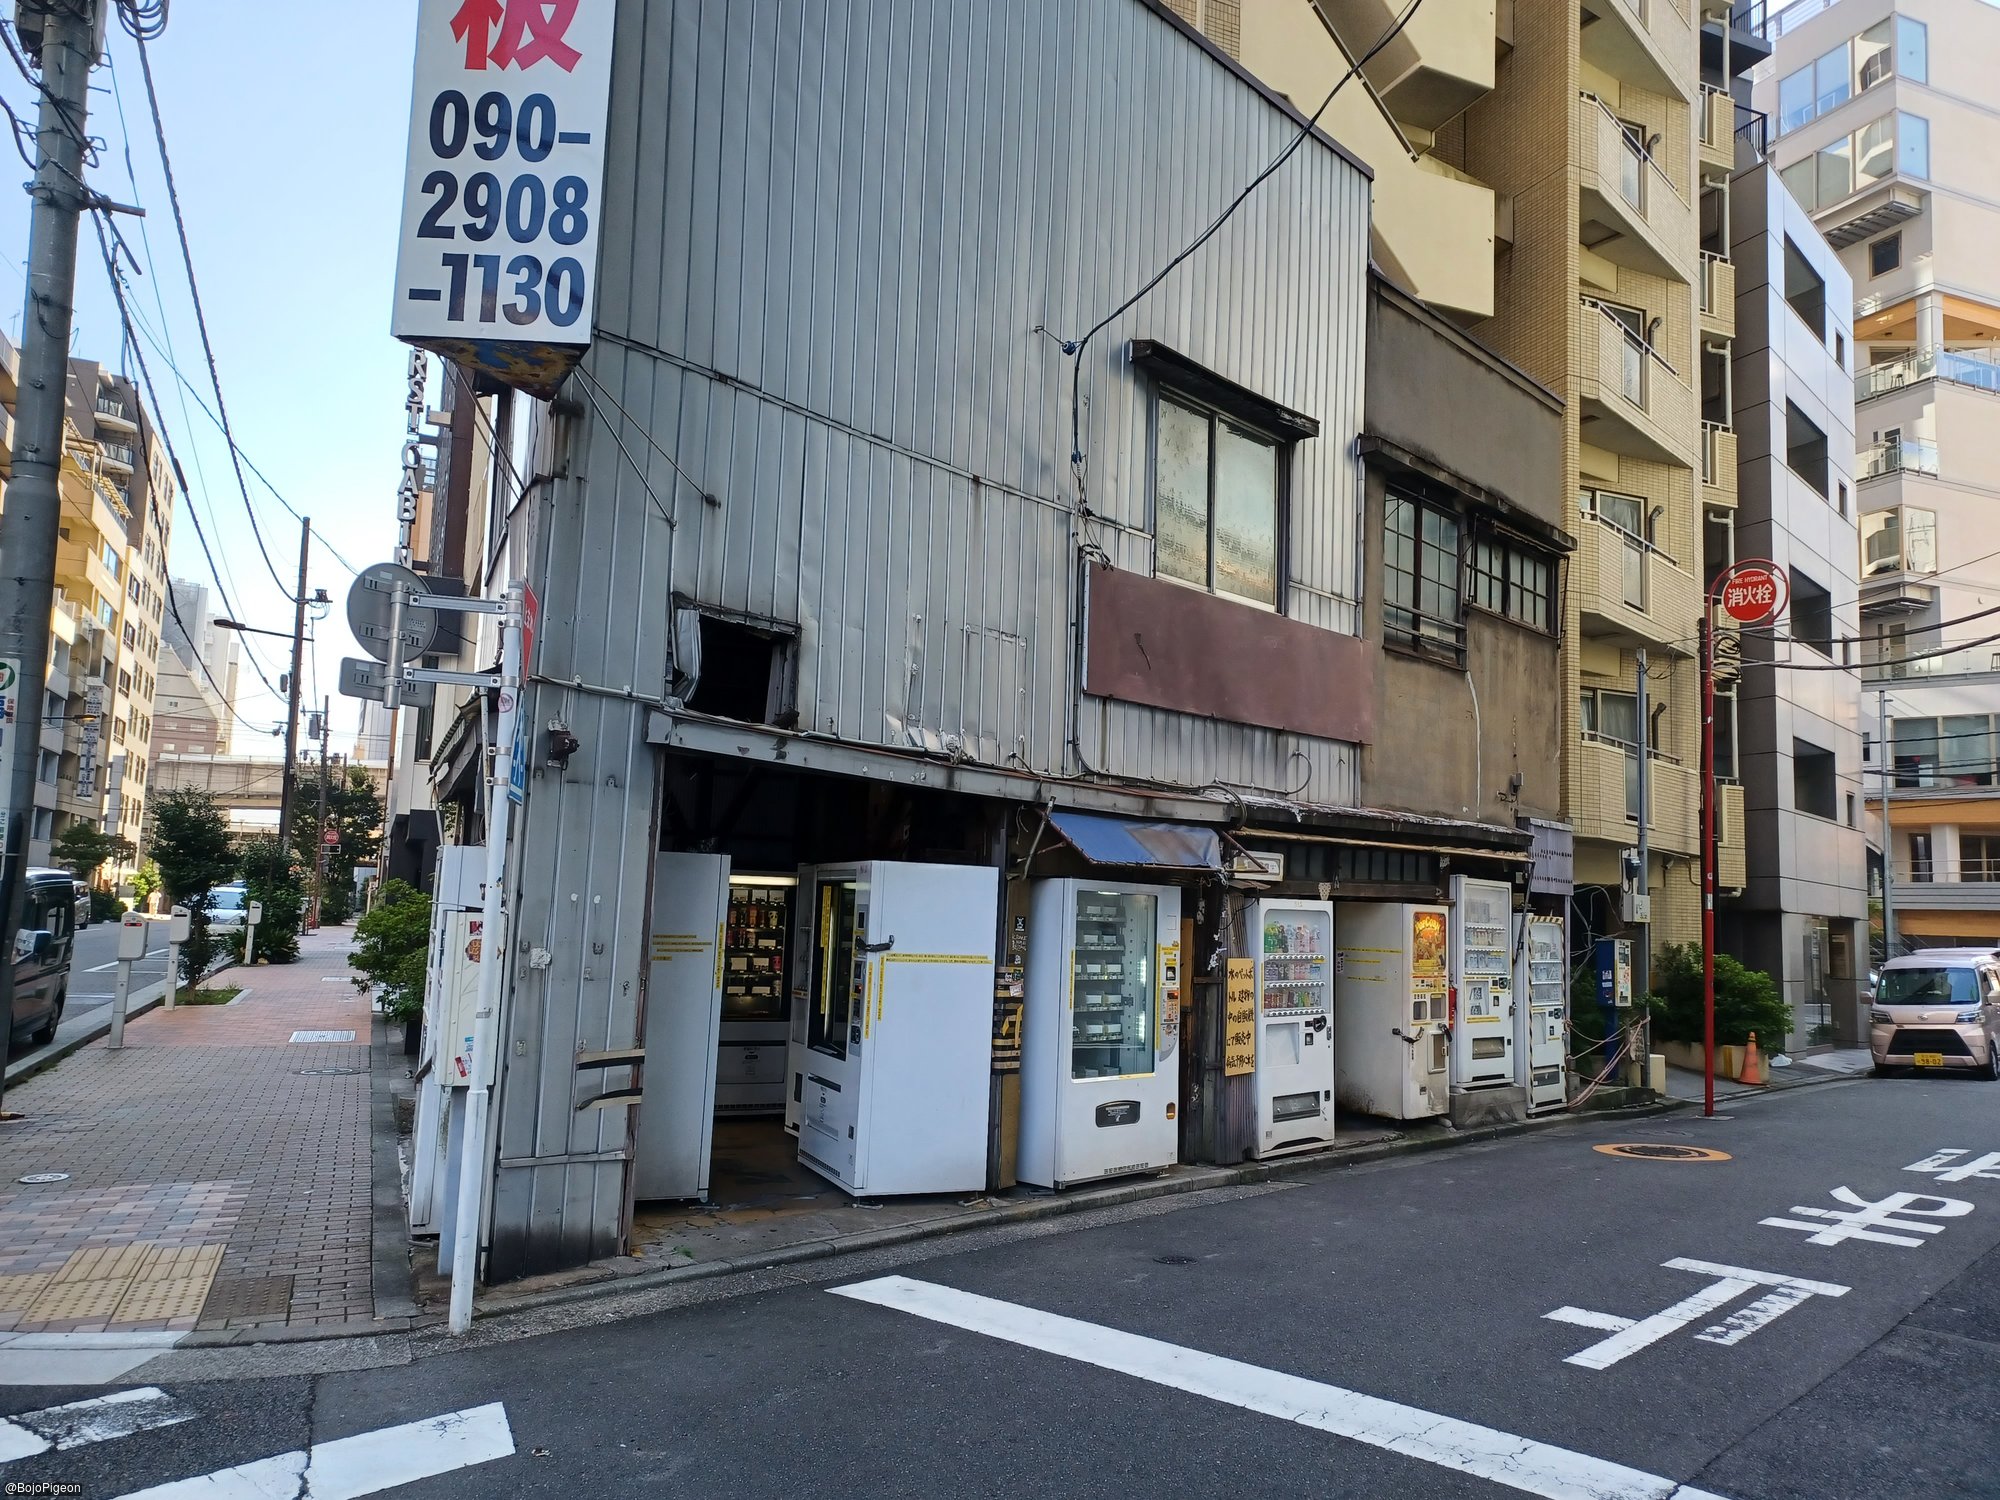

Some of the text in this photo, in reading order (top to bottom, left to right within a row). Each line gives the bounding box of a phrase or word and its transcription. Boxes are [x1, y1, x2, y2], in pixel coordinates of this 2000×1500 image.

[429, 89, 591, 163] 090-
[416, 170, 589, 246] 2908
[408, 252, 586, 327] -1130
[394, 441, 420, 569] CABIN
[1728, 583, 1773, 608] 消火栓
[1744, 575, 1768, 583] HYDRANT
